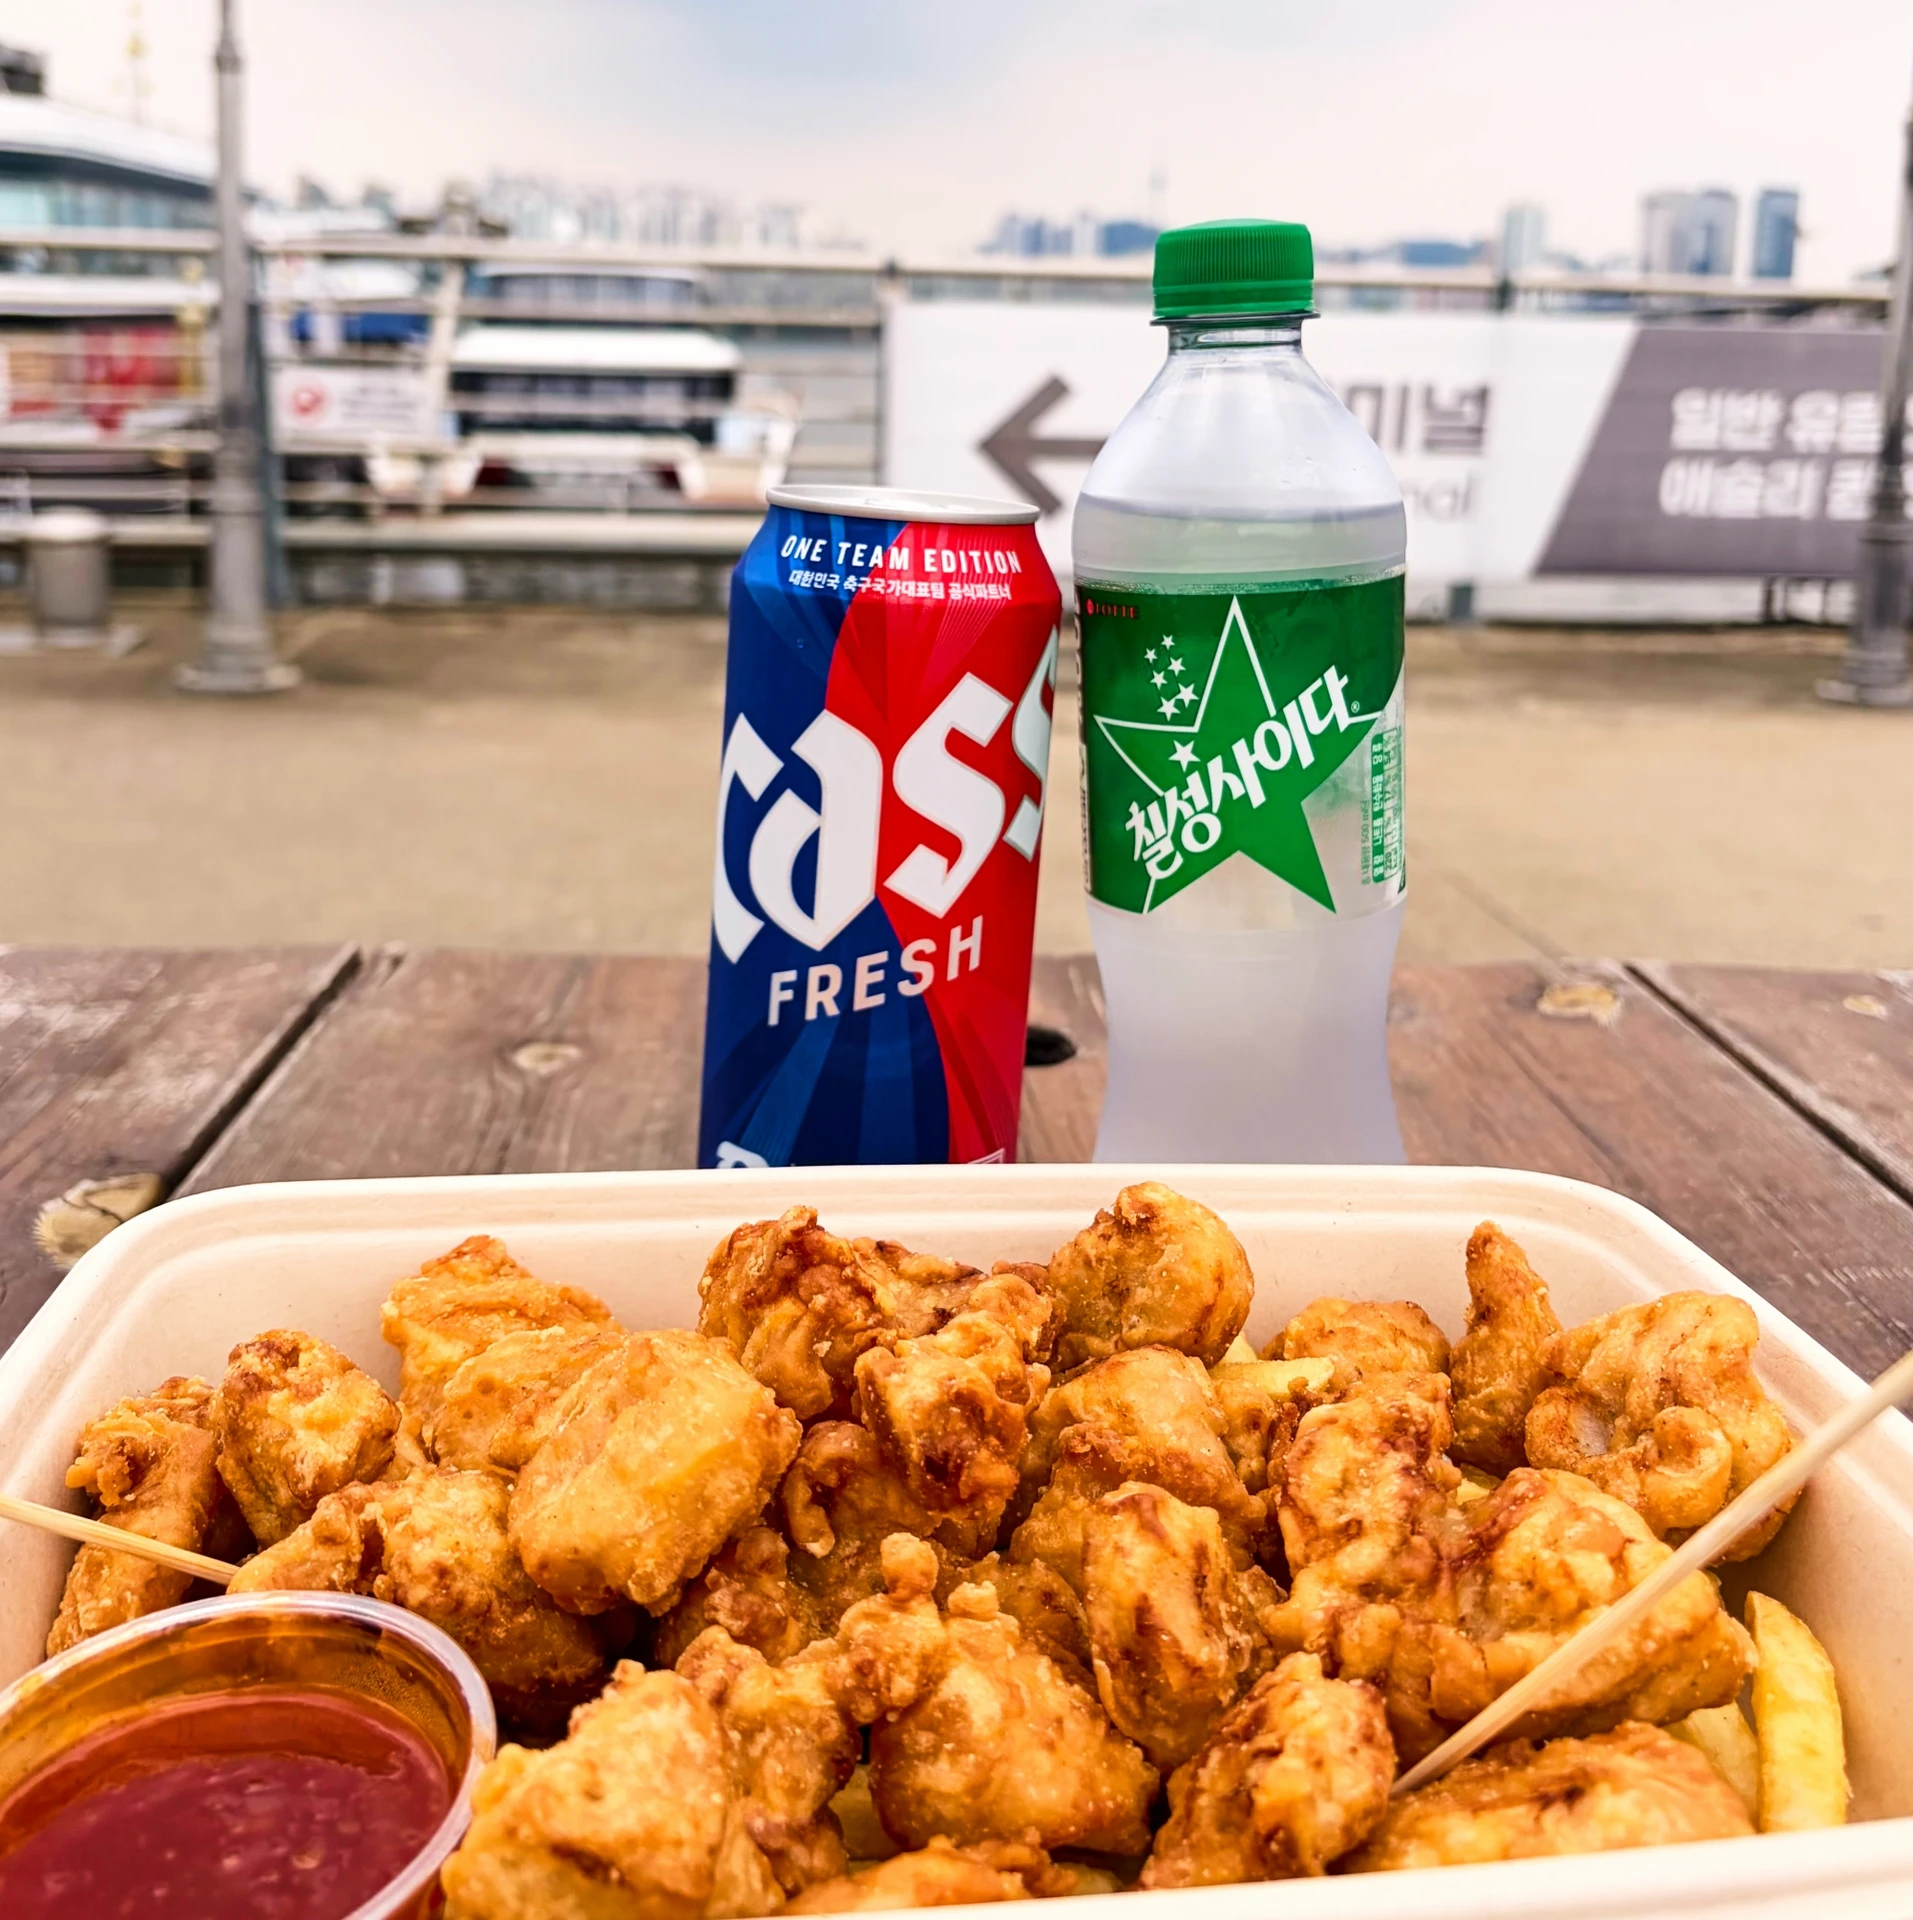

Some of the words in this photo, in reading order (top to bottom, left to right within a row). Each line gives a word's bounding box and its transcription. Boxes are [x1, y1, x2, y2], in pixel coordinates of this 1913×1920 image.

[1340, 382, 1490, 455] 미널
[781, 535, 827, 562] ONE
[837, 542, 910, 570] TEAM
[924, 548, 1022, 574] EDITION
[788, 569, 841, 590] 대한민국
[843, 575, 945, 599] 축구국가대표팀
[948, 582, 1012, 600] 공식파트너
[1125, 664, 1349, 880] 칠성사이다
[767, 915, 983, 1026] FRESH
